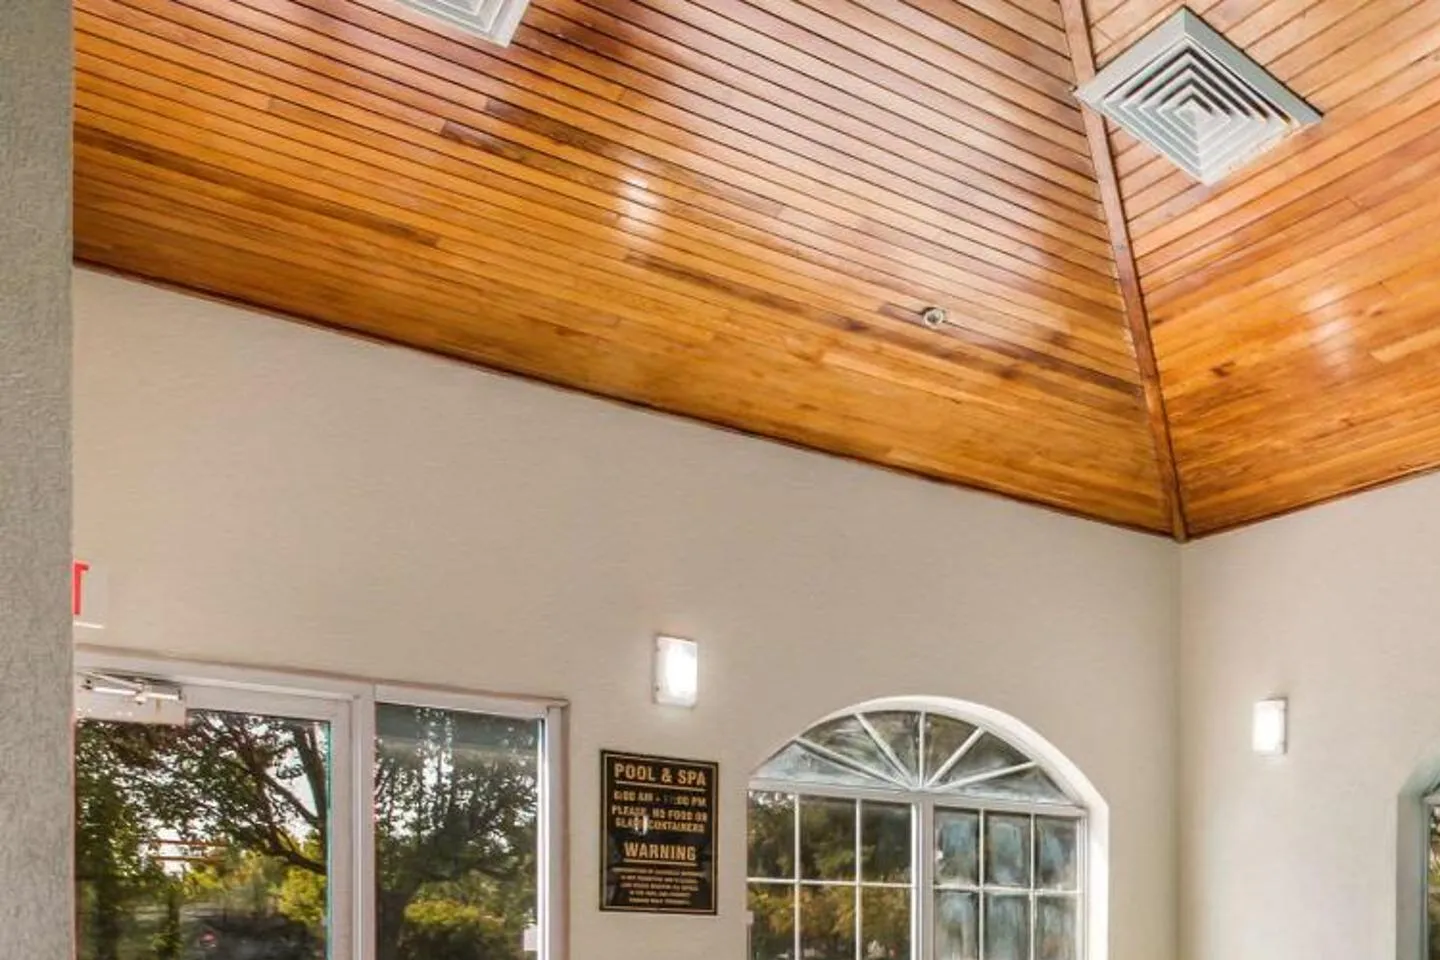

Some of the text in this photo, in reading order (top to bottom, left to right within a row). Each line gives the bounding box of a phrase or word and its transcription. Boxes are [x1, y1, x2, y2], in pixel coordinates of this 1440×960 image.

[614, 763, 706, 786] POOL & SPA
[623, 841, 697, 861] WARNING
